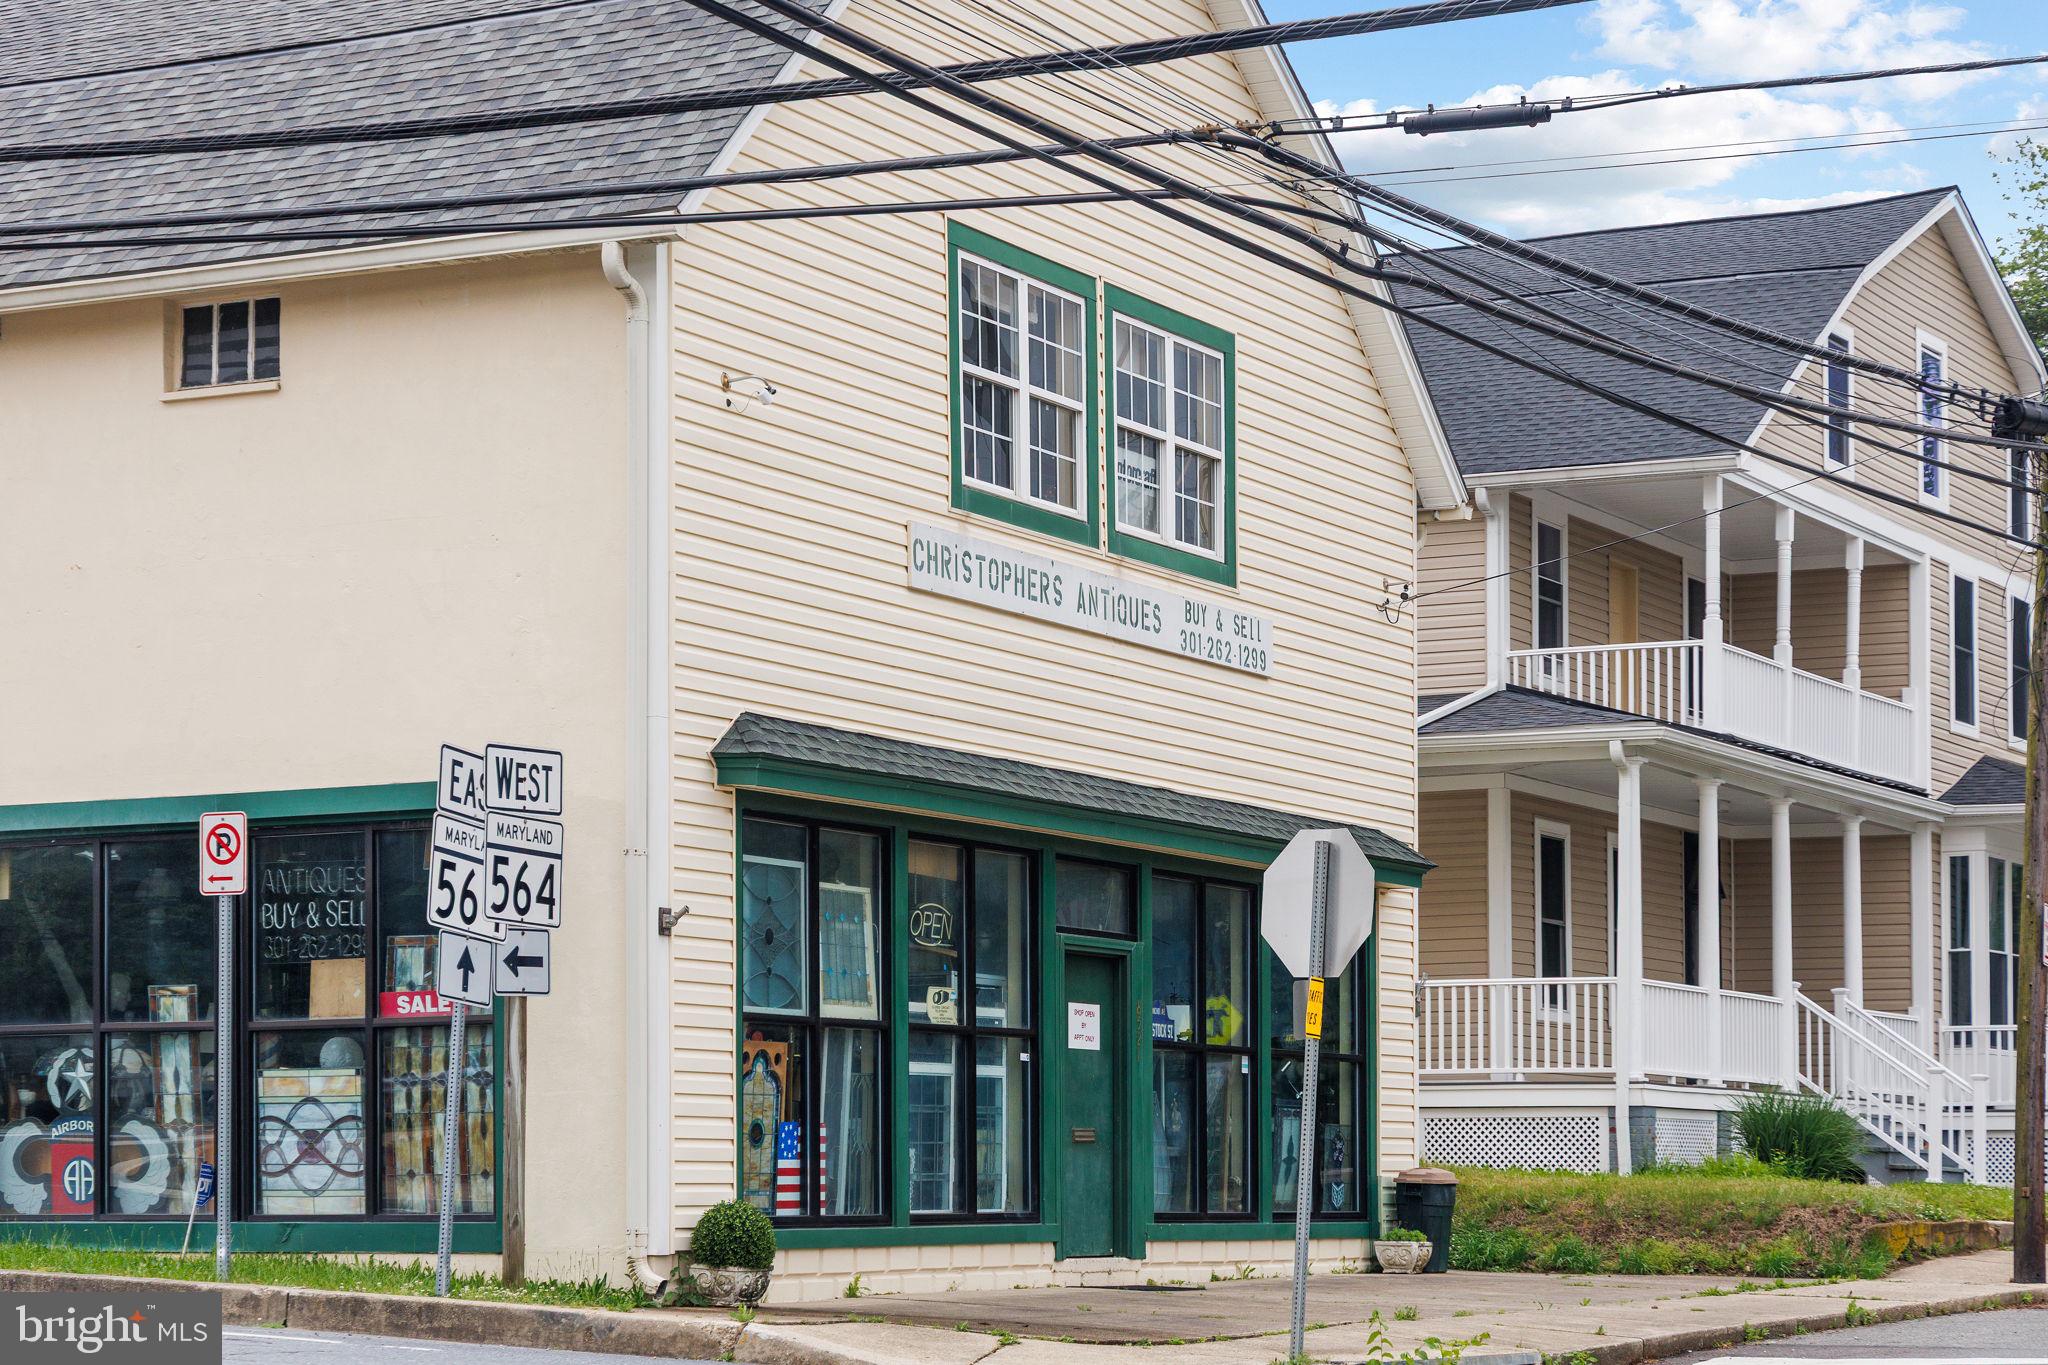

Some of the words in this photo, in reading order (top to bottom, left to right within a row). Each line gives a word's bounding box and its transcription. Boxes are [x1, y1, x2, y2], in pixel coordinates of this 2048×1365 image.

[1184, 600, 1207, 627] BUY
[1215, 609, 1223, 632] &
[1233, 614, 1262, 643] SELL
[450, 758, 485, 811] EA
[495, 756, 553, 803] WEST
[496, 822, 553, 845] MARYLAND
[435, 859, 478, 926] 56
[491, 855, 556, 920] 564
[262, 902, 300, 929] BUY
[306, 901, 320, 929] &
[326, 899, 366, 927] SELL
[910, 910, 953, 940] OPEN
[396, 994, 451, 1014] SALE
[1084, 1010, 1095, 1018] OPEN
[51, 1120, 94, 1138] AIRBOR
